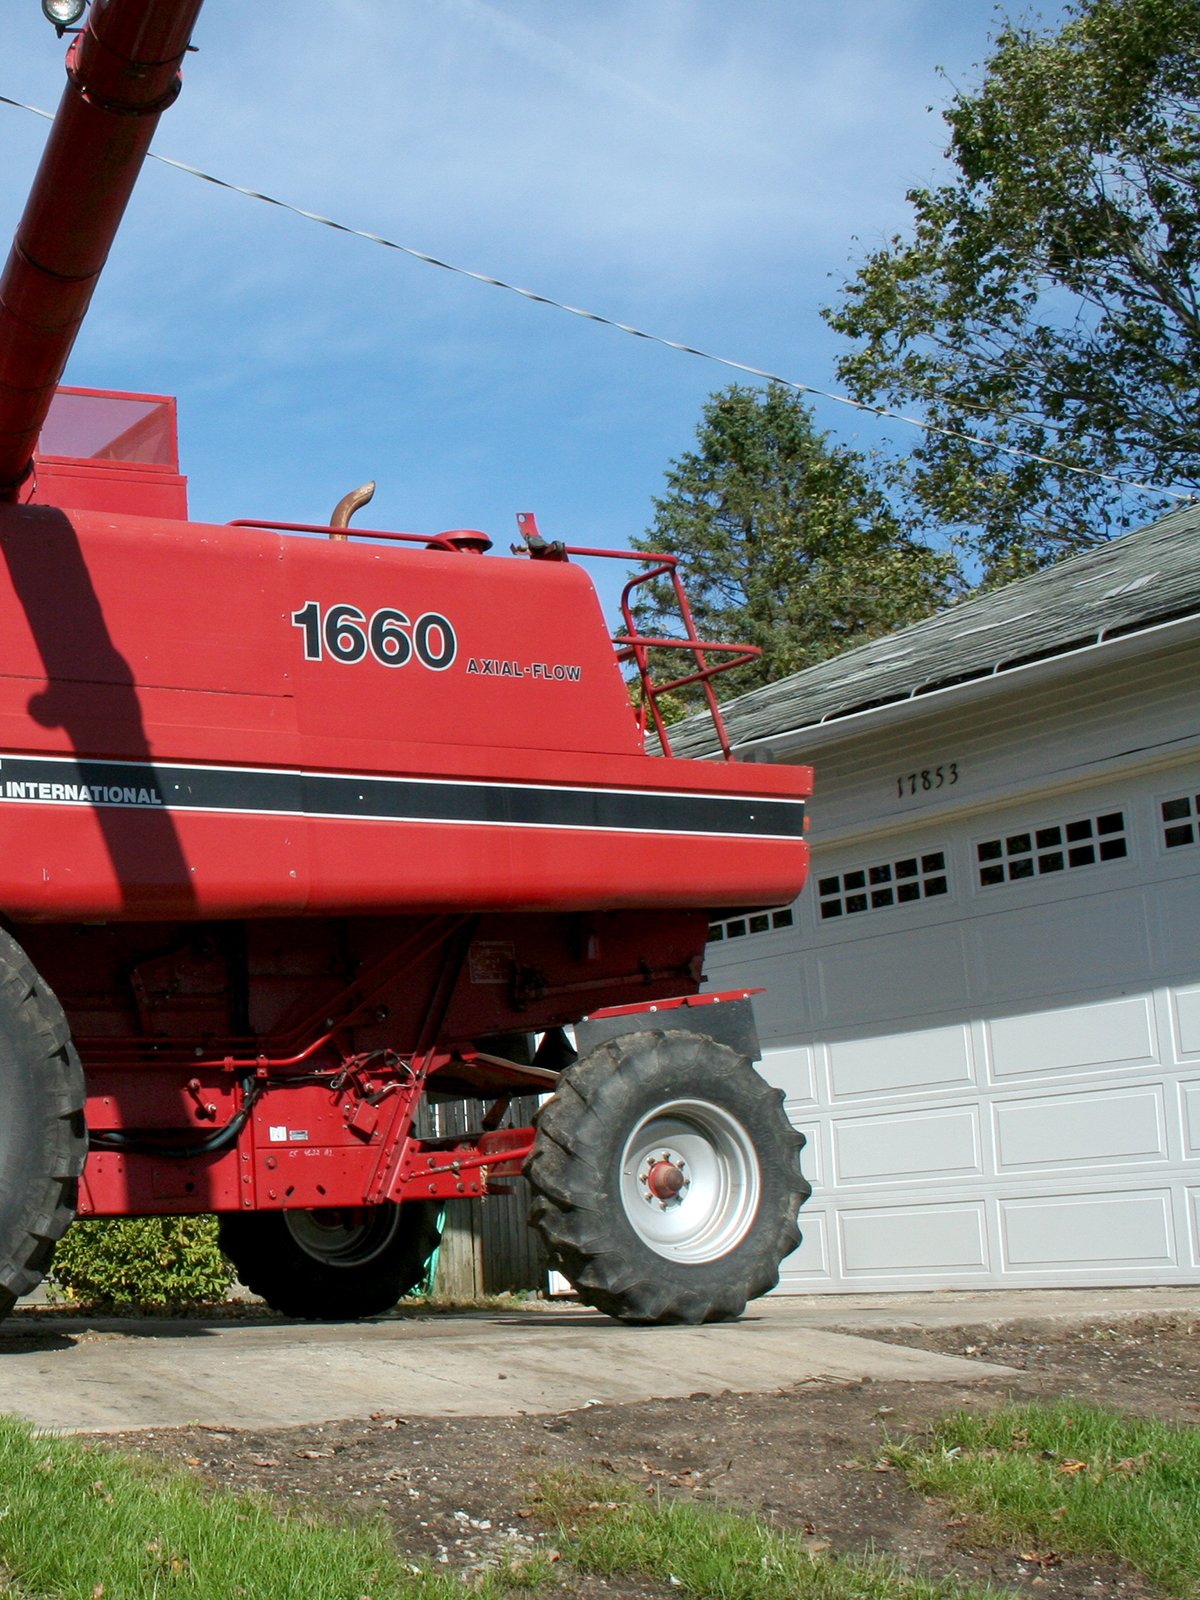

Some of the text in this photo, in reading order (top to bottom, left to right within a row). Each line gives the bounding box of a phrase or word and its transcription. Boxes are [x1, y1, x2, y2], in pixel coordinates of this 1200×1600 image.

[291, 601, 582, 682] 1660 AXIAL-FLOW
[6, 781, 162, 805] INTERNATIONAL
[896, 762, 959, 799] 17853
